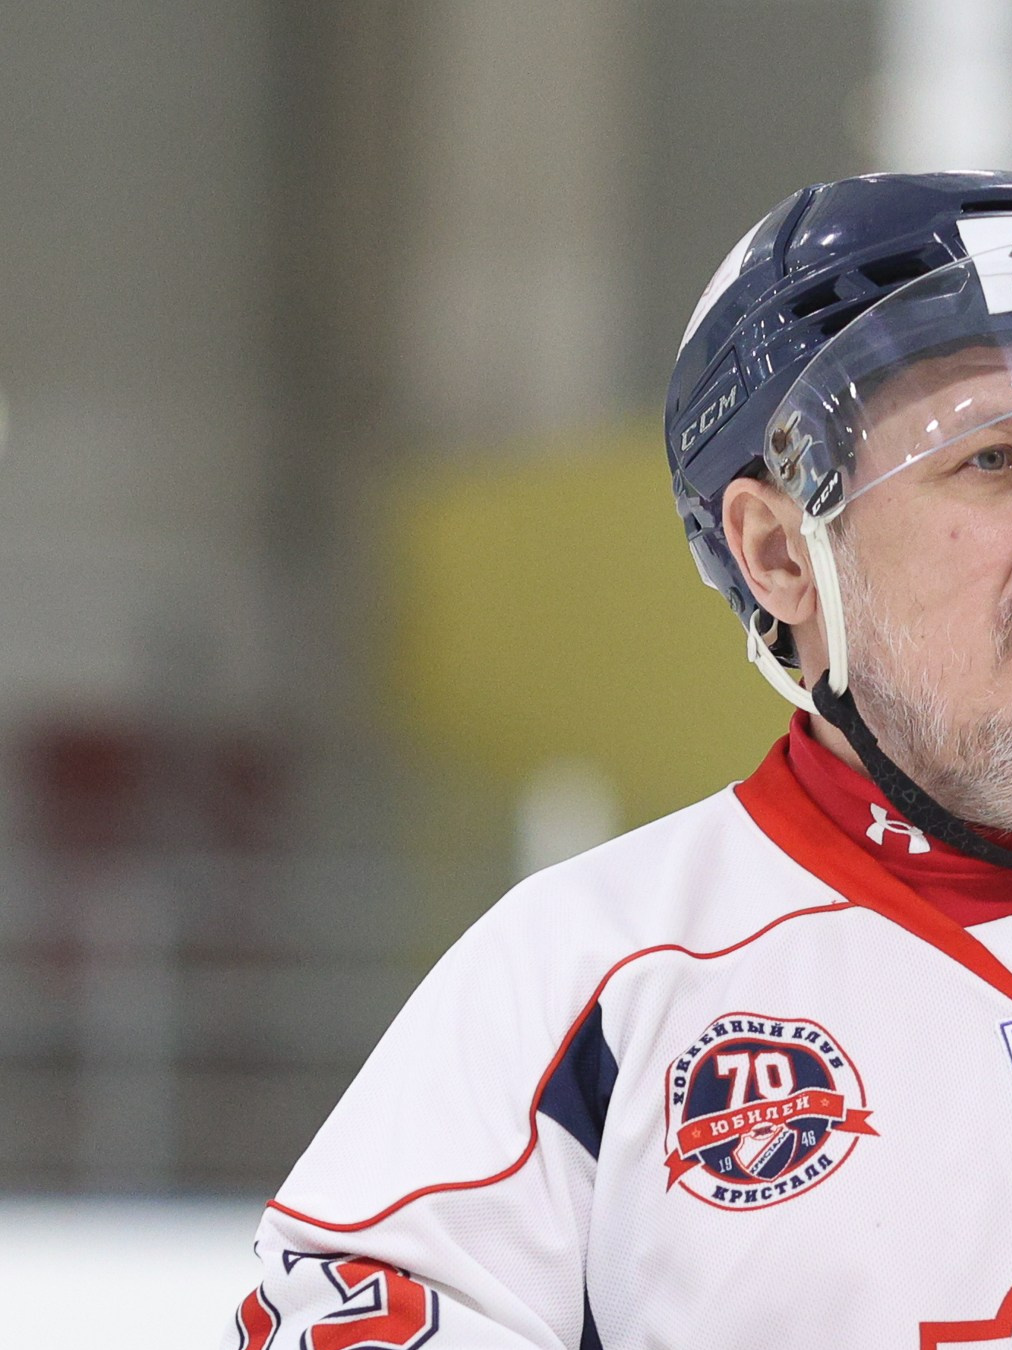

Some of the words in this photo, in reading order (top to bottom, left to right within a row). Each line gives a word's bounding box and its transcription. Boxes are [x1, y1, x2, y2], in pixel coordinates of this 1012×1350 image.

[681, 385, 737, 452] CCM
[812, 472, 839, 516] CCM
[673, 1020, 784, 1106] ХОККЕЙНЫЙ
[792, 1026, 844, 1070] КЛУБ
[716, 1052, 794, 1110] 70
[709, 1094, 810, 1137] ЮБИЛЕЙ
[718, 1156, 733, 1174] 19
[801, 1130, 816, 1147] 46
[711, 1153, 834, 1204] КРИСТАЛЛ
